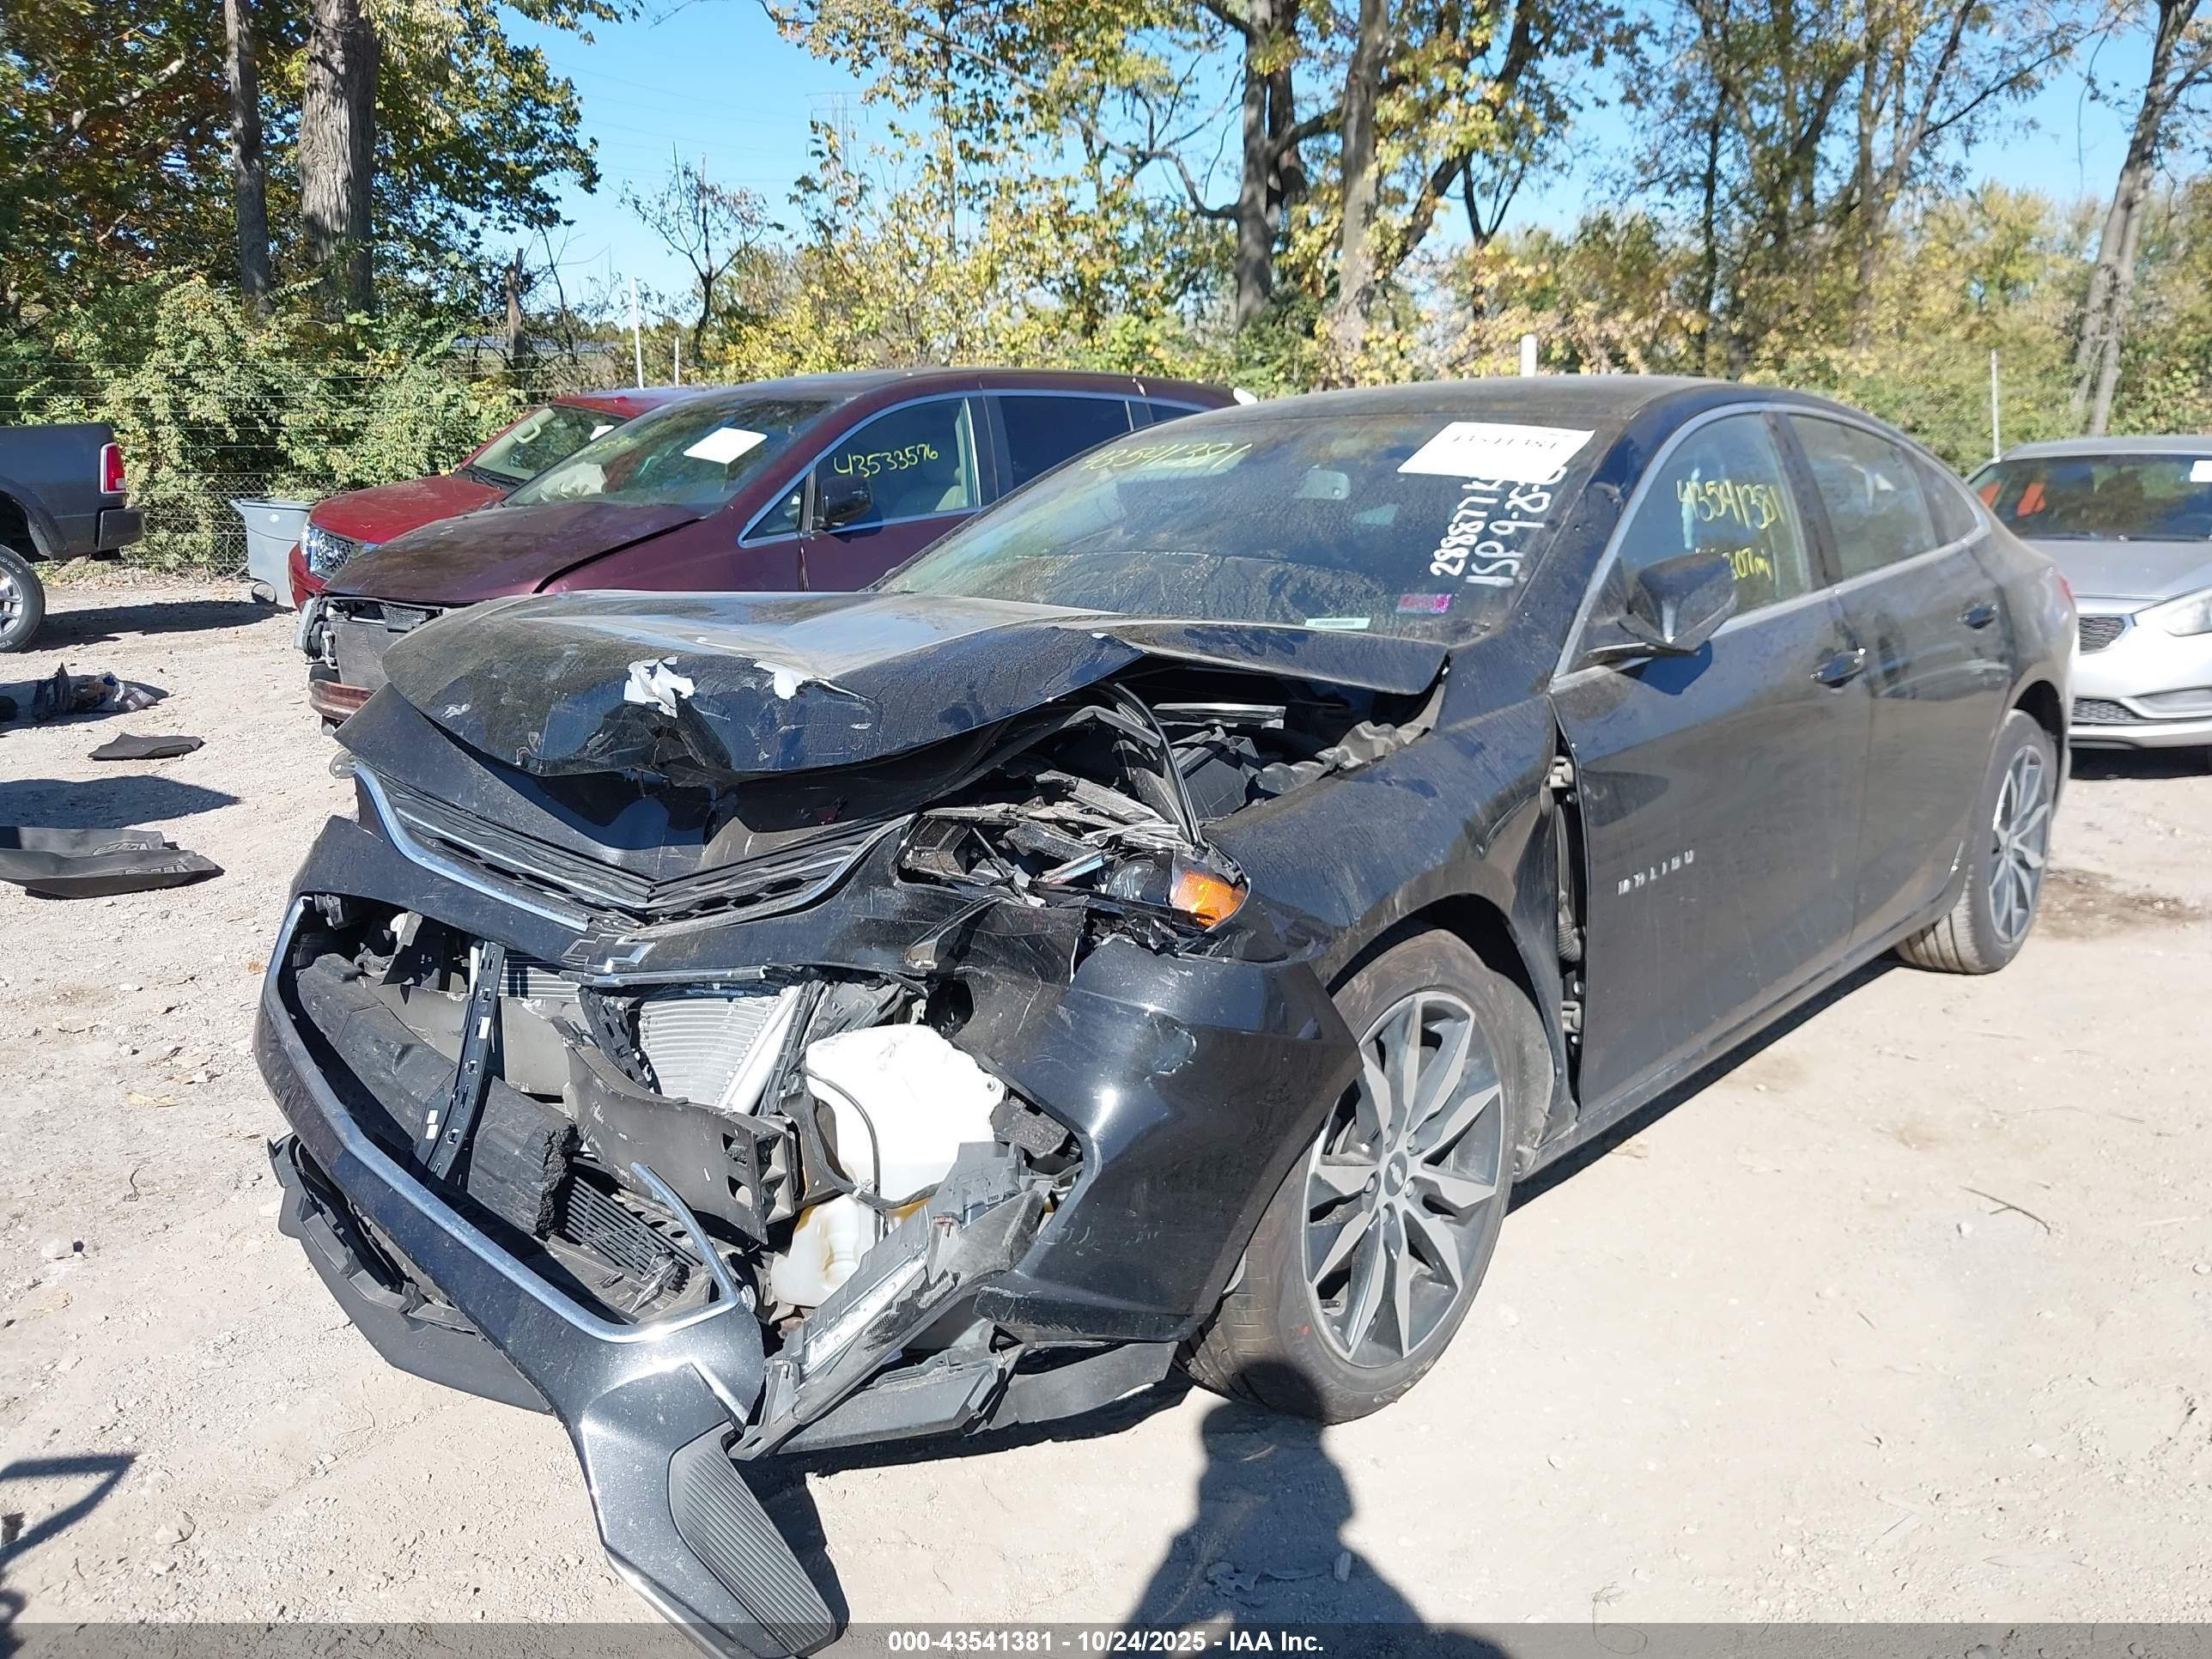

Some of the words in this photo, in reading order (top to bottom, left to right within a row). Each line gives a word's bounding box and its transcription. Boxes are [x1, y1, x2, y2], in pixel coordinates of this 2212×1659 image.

[833, 443, 939, 477] 43533576
[1676, 478, 1786, 530] 43541381
[1618, 848, 1694, 896] MALIBU
